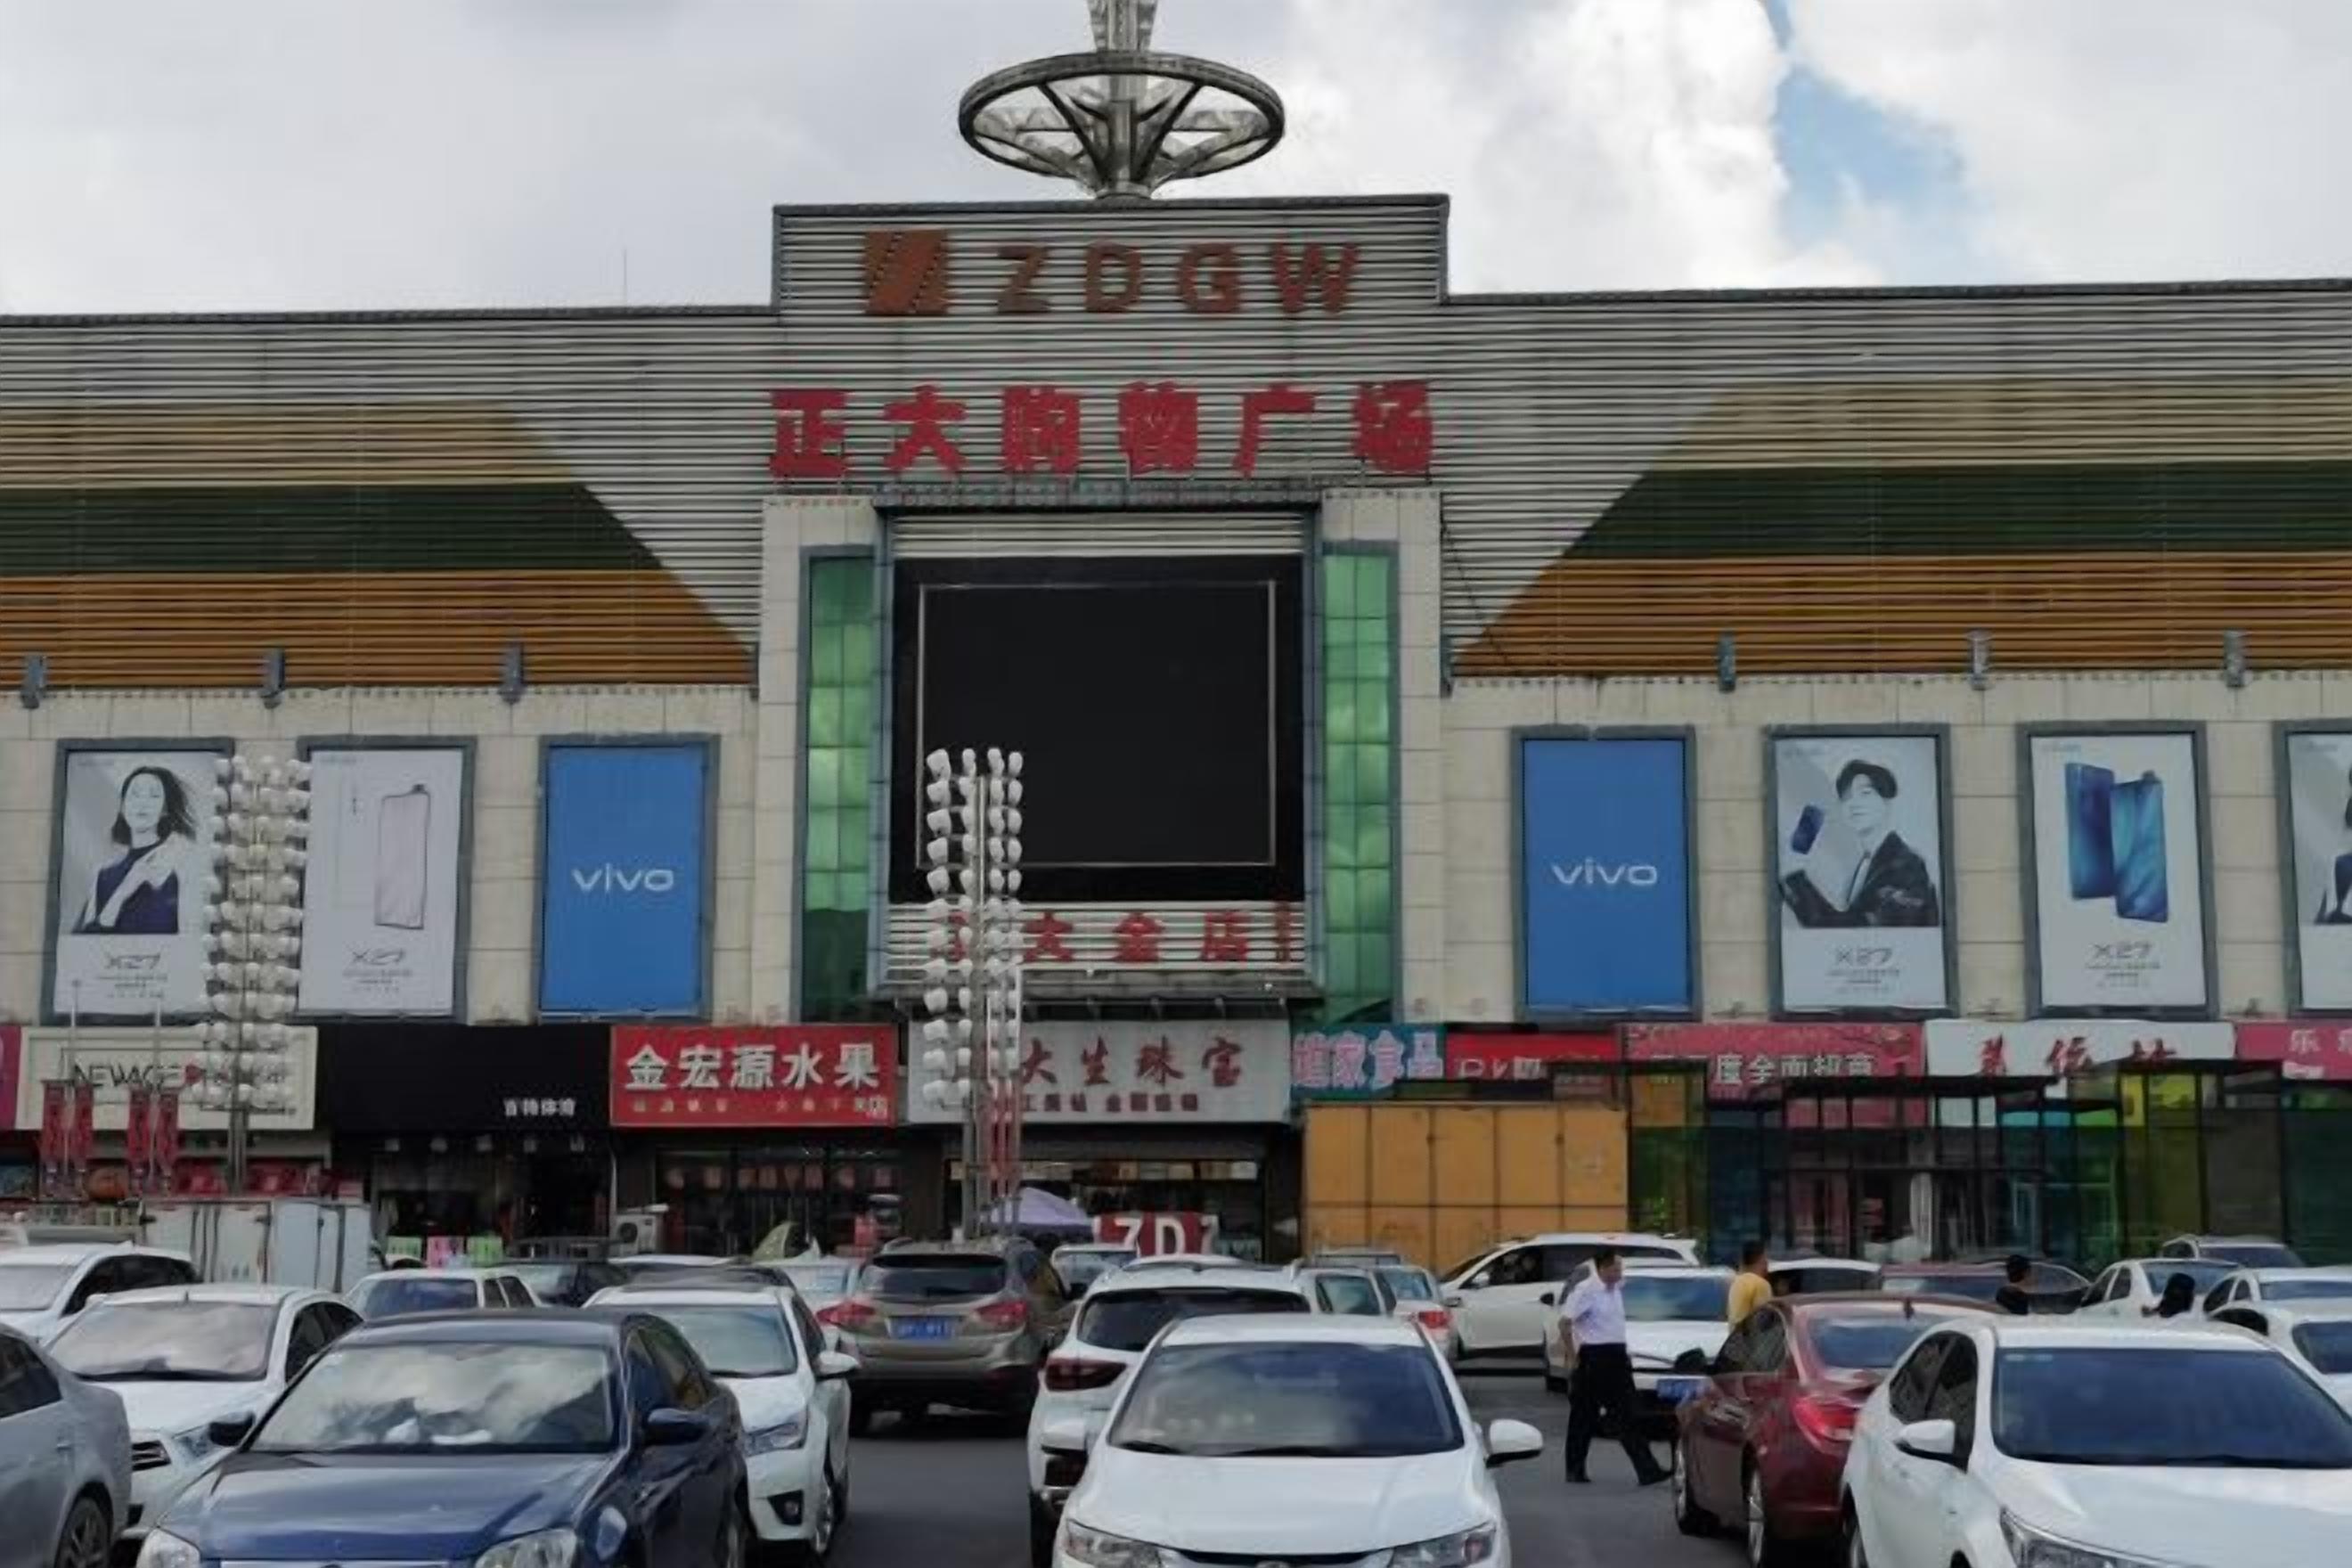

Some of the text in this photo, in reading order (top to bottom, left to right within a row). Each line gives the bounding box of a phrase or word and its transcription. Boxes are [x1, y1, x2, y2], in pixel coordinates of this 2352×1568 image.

[996, 240, 1360, 315] ZDGW
[769, 380, 1433, 478] 正大购物广场
[571, 862, 675, 894] vivo
[1551, 857, 1658, 886] vivo
[625, 1042, 880, 1090] 金宏源水果
[1653, 1053, 1875, 1085] 度全面招商
